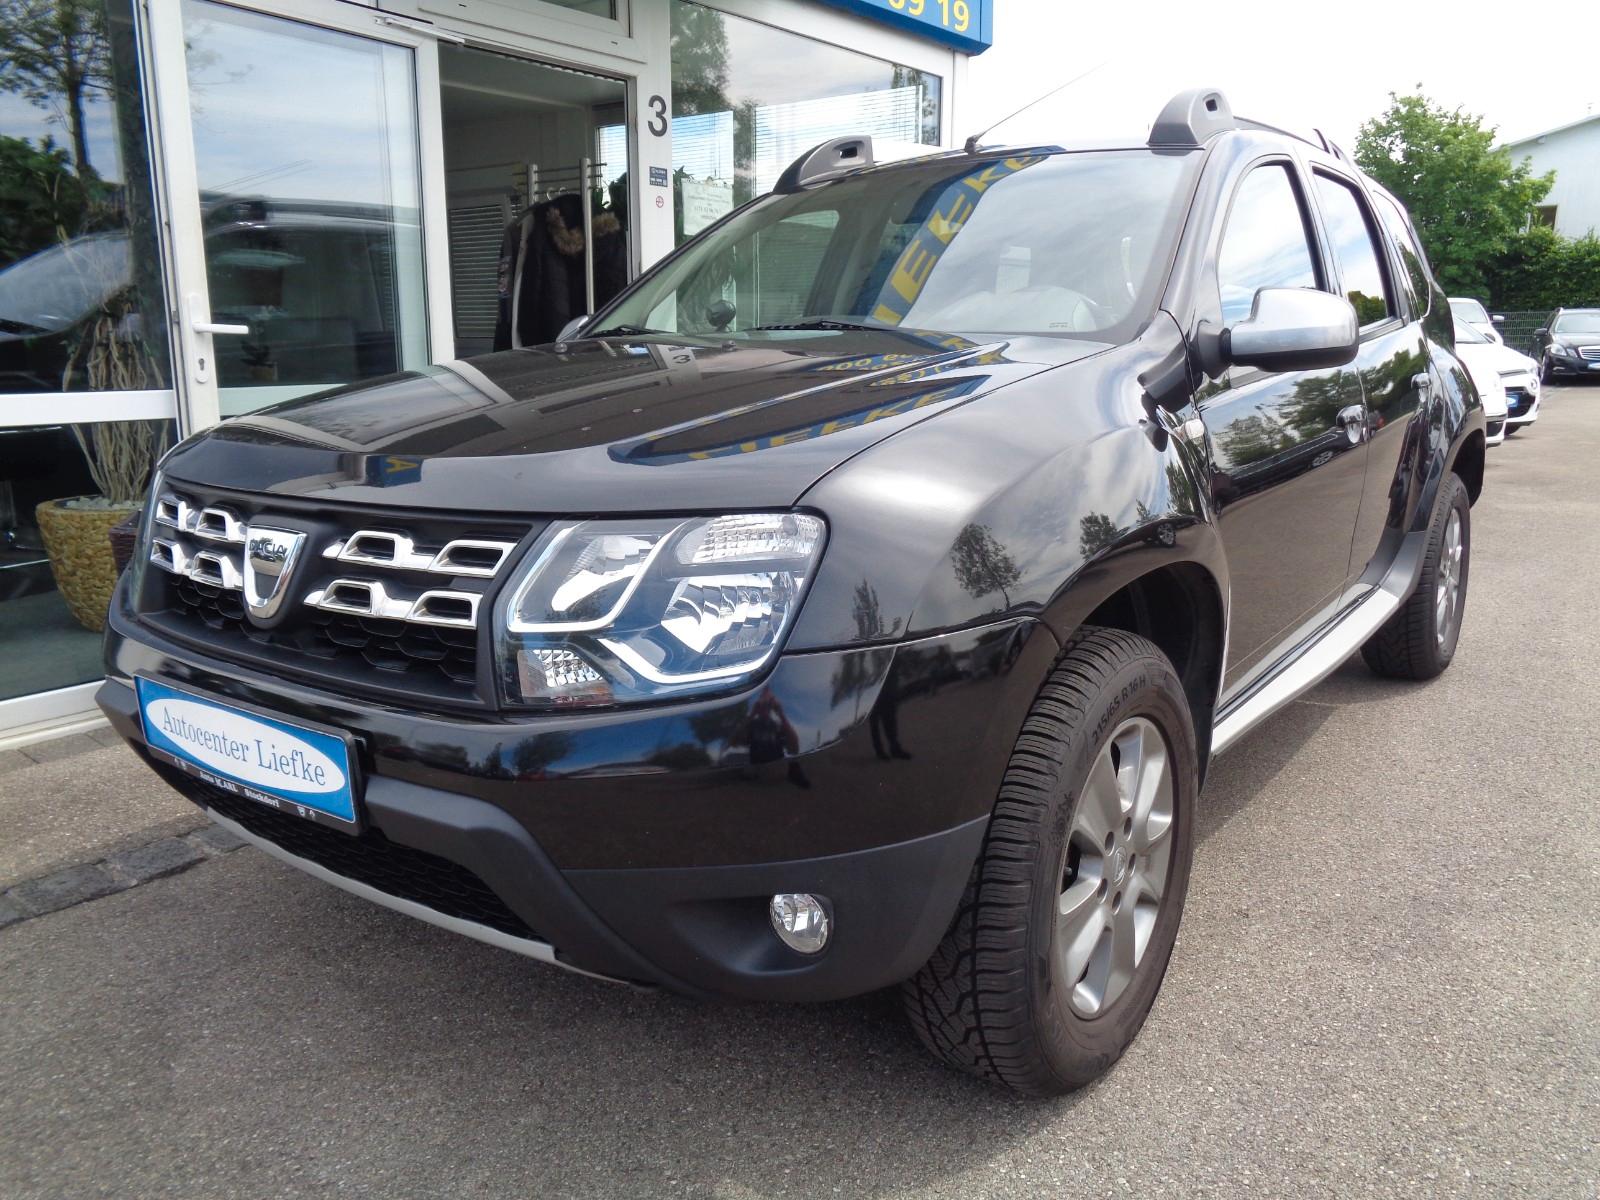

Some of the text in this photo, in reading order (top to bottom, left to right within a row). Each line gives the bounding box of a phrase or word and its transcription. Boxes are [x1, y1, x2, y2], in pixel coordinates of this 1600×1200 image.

[938, 0, 970, 33] 19
[647, 94, 668, 138] 3
[249, 537, 287, 557] DACIA
[1092, 696, 1121, 746] 215/65
[162, 706, 327, 787] Autocenter Liefke
